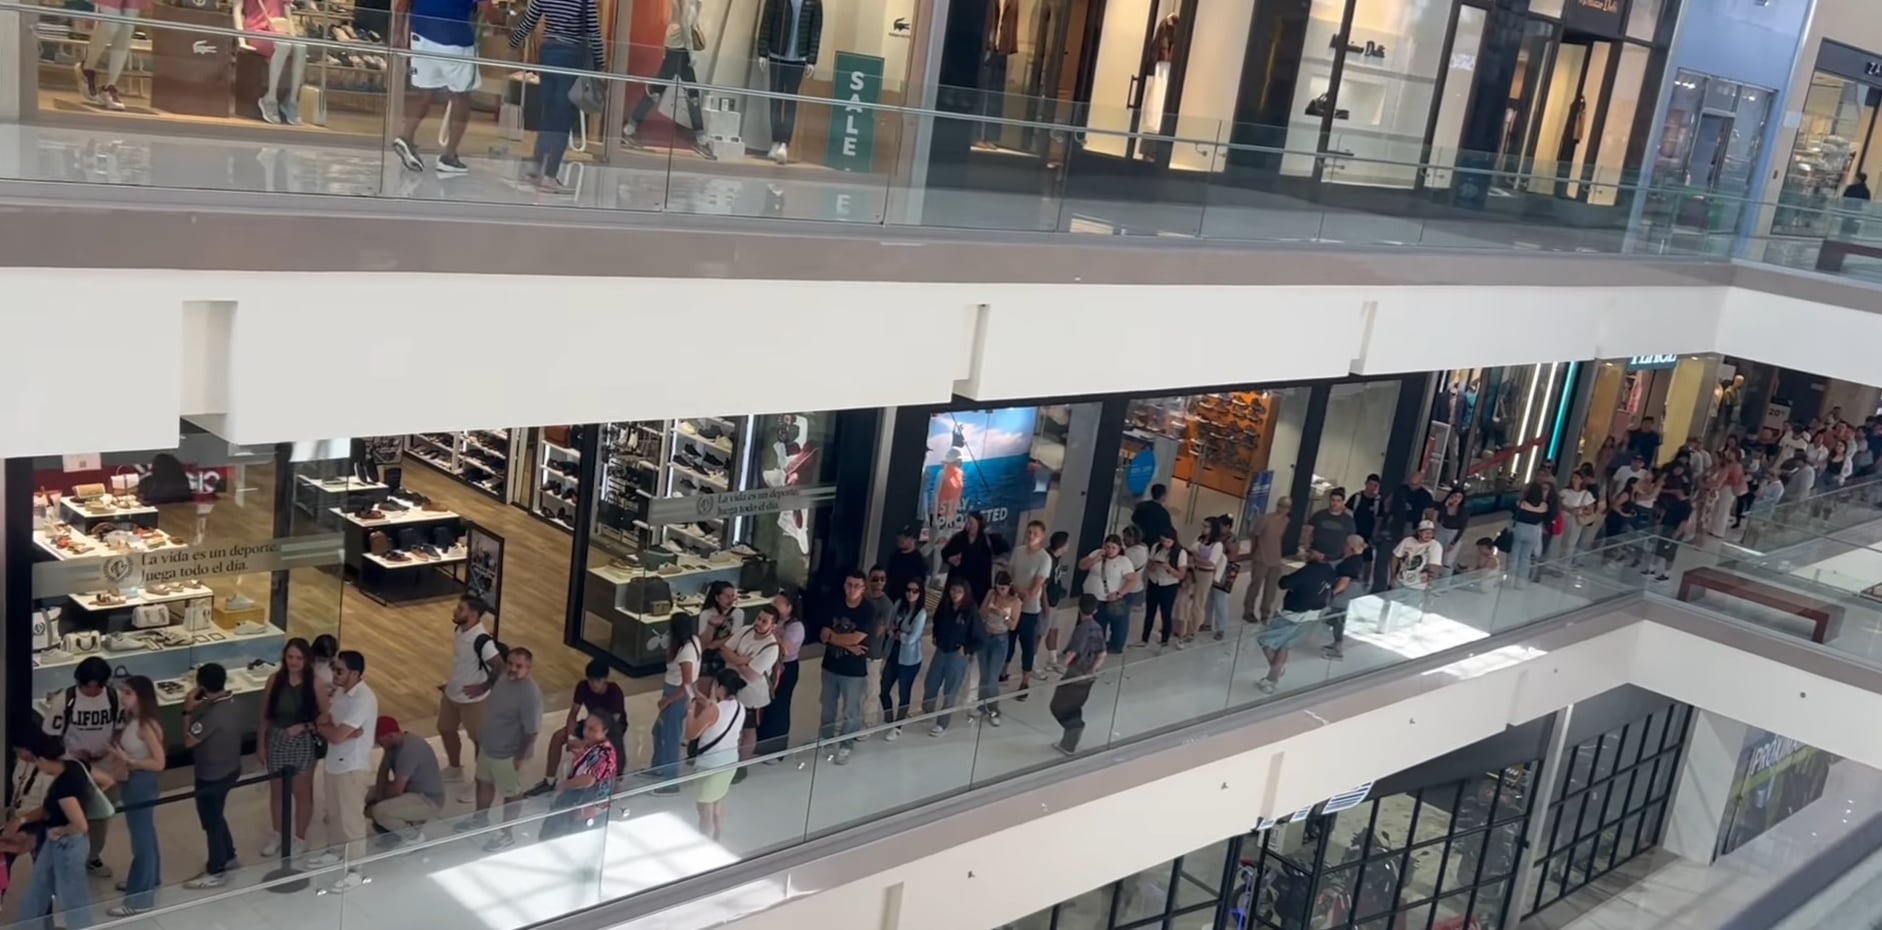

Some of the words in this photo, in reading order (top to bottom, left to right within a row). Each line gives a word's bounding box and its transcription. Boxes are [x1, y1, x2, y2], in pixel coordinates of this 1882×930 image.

[1867, 62, 1882, 78] ZA
[842, 71, 865, 156] SALE
[142, 553, 157, 567] La
[161, 550, 190, 565] vida
[192, 551, 206, 561] es
[209, 546, 227, 560] un
[180, 565, 209, 579] todo
[212, 562, 223, 575] el
